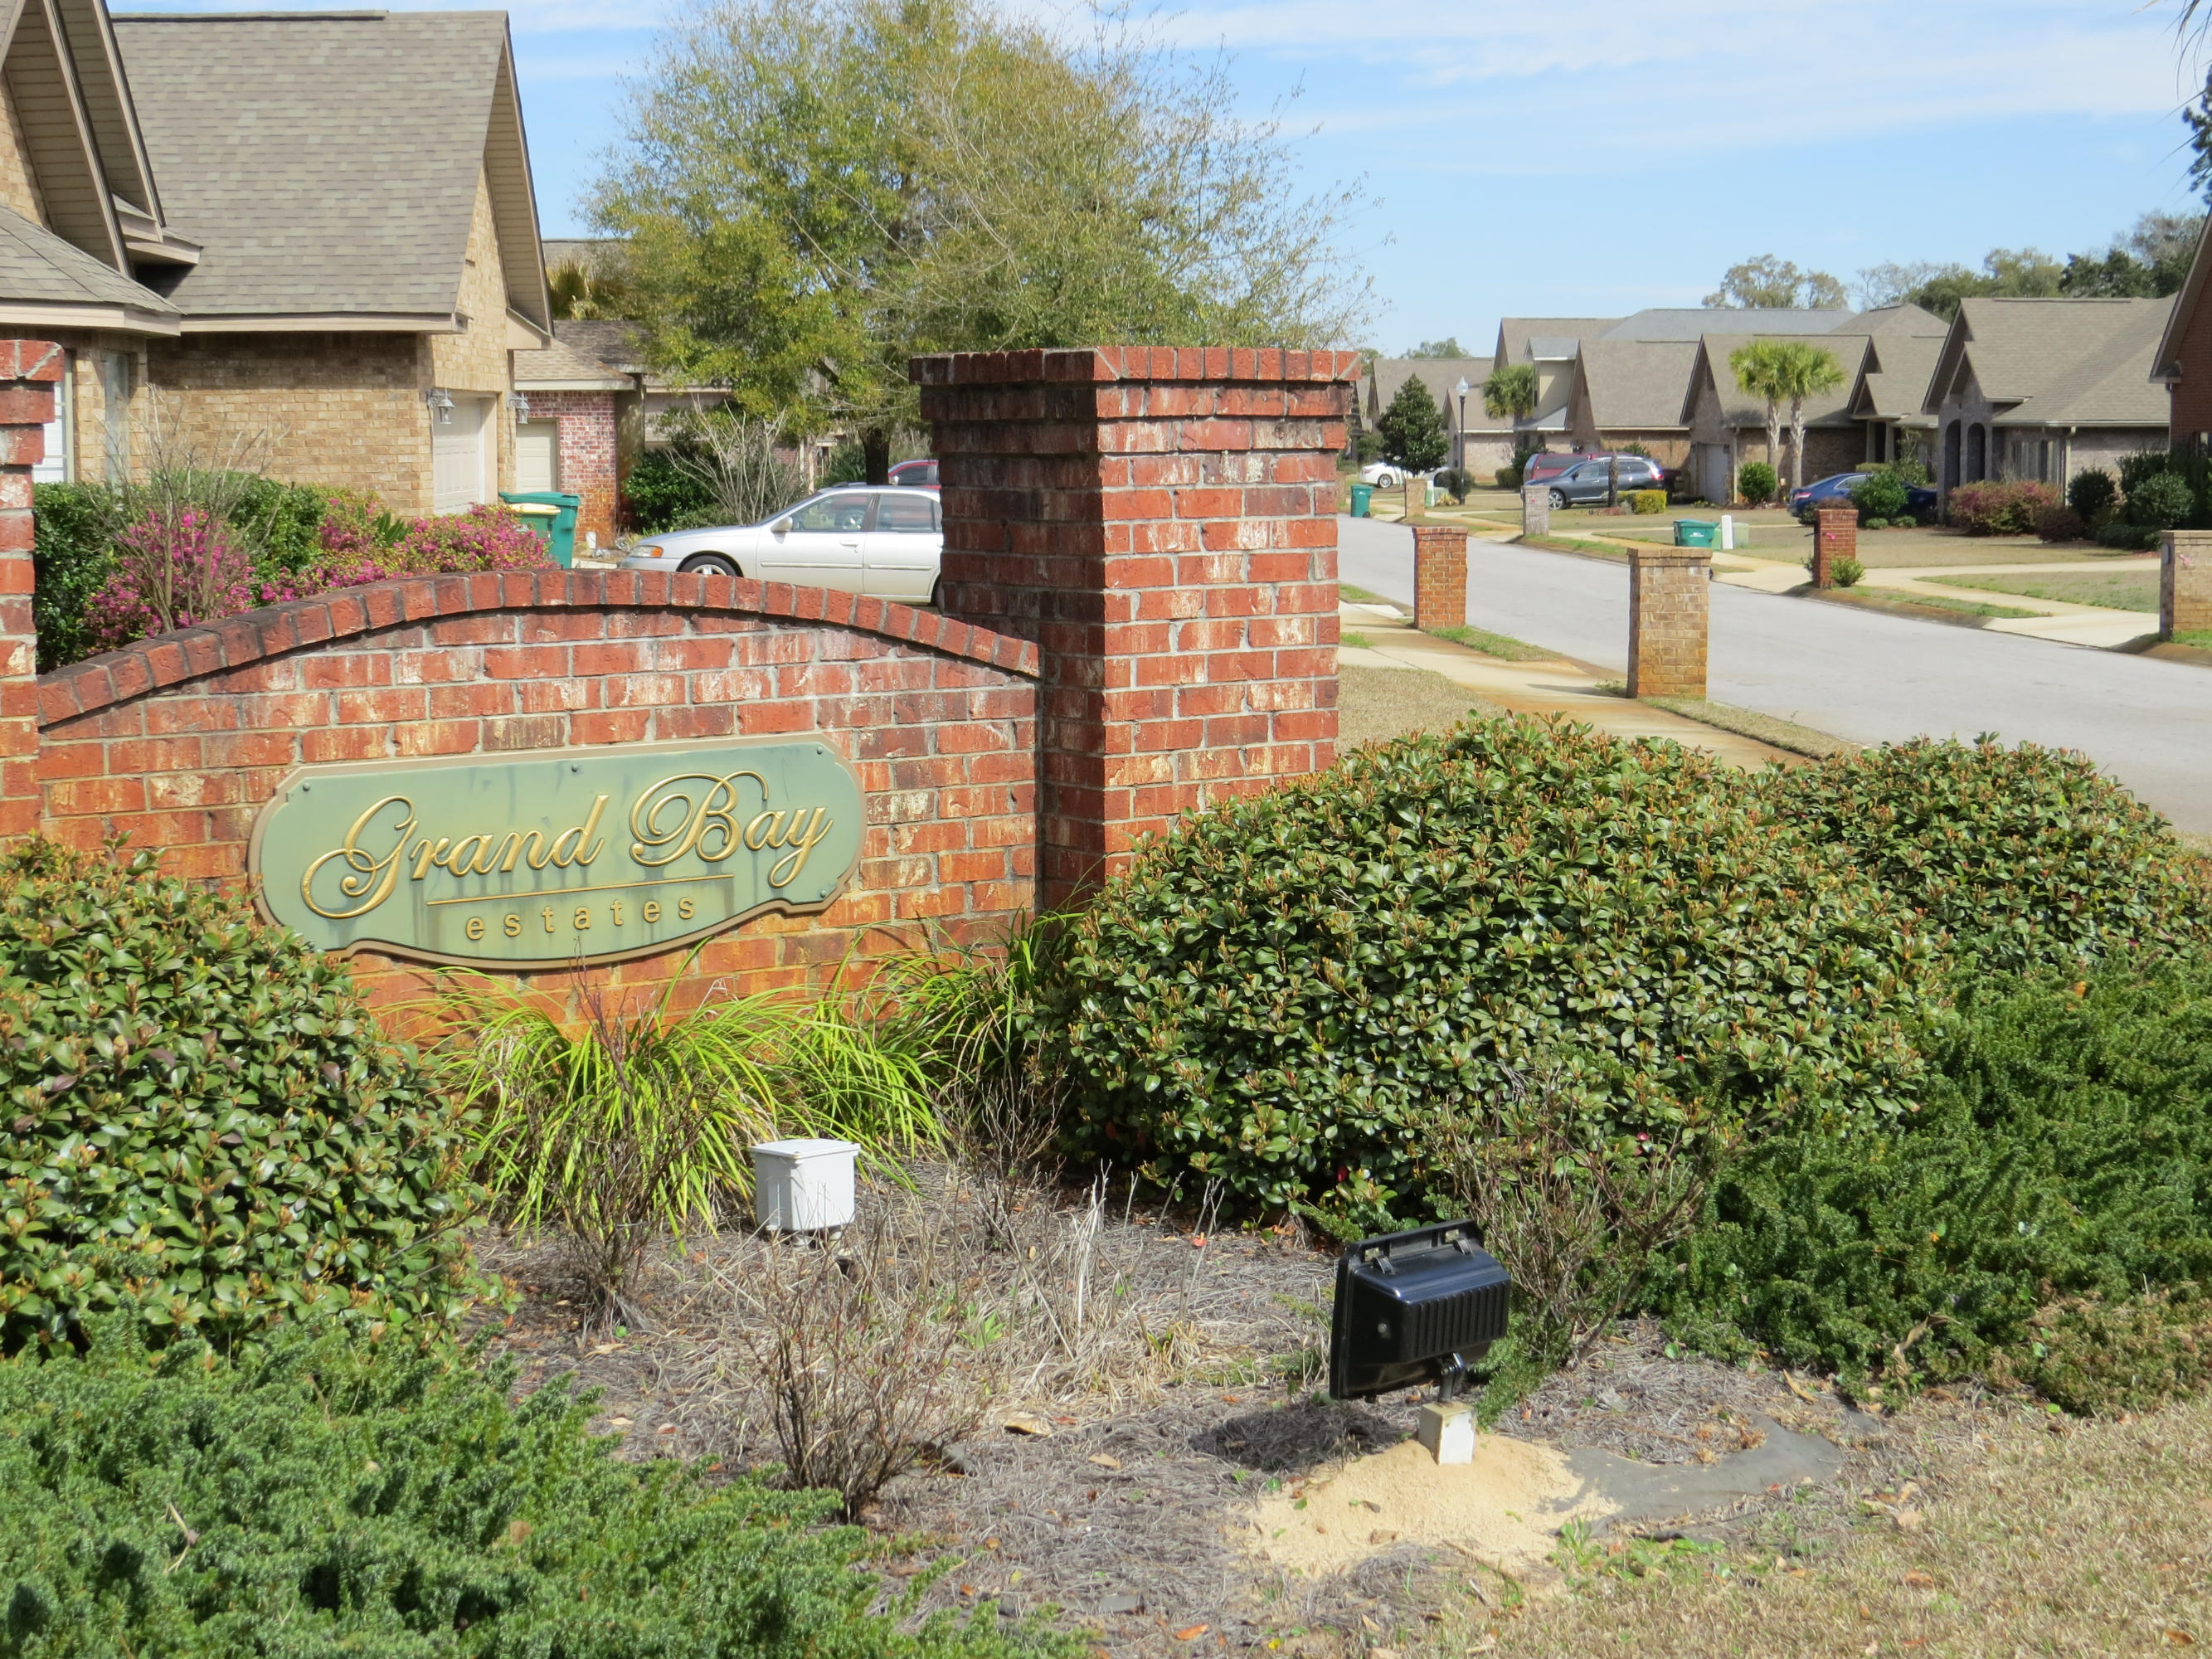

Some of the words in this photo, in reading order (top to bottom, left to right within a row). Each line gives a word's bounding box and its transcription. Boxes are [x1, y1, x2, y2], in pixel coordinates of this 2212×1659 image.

[301, 794, 608, 918] Grand
[630, 771, 834, 888] Bay
[465, 896, 695, 941] estates
